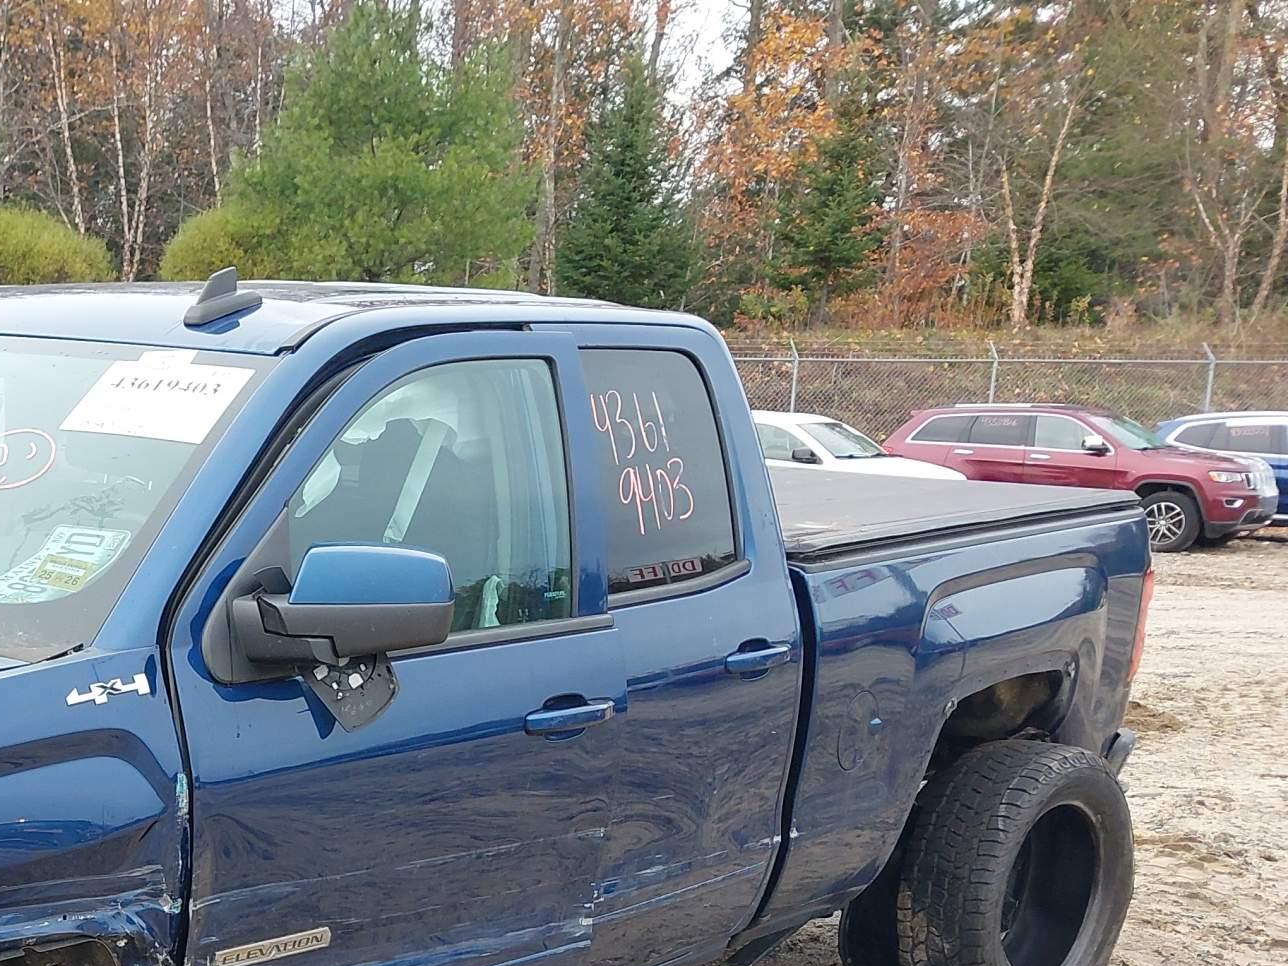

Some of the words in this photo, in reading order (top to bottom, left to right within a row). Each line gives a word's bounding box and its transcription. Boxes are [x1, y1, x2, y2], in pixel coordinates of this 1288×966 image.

[110, 375, 222, 397] 43619403
[589, 389, 671, 466] 4361
[618, 456, 696, 536] 9403
[38, 569, 55, 580] 25
[64, 575, 81, 586] 26
[221, 933, 325, 966] ELEVATION
